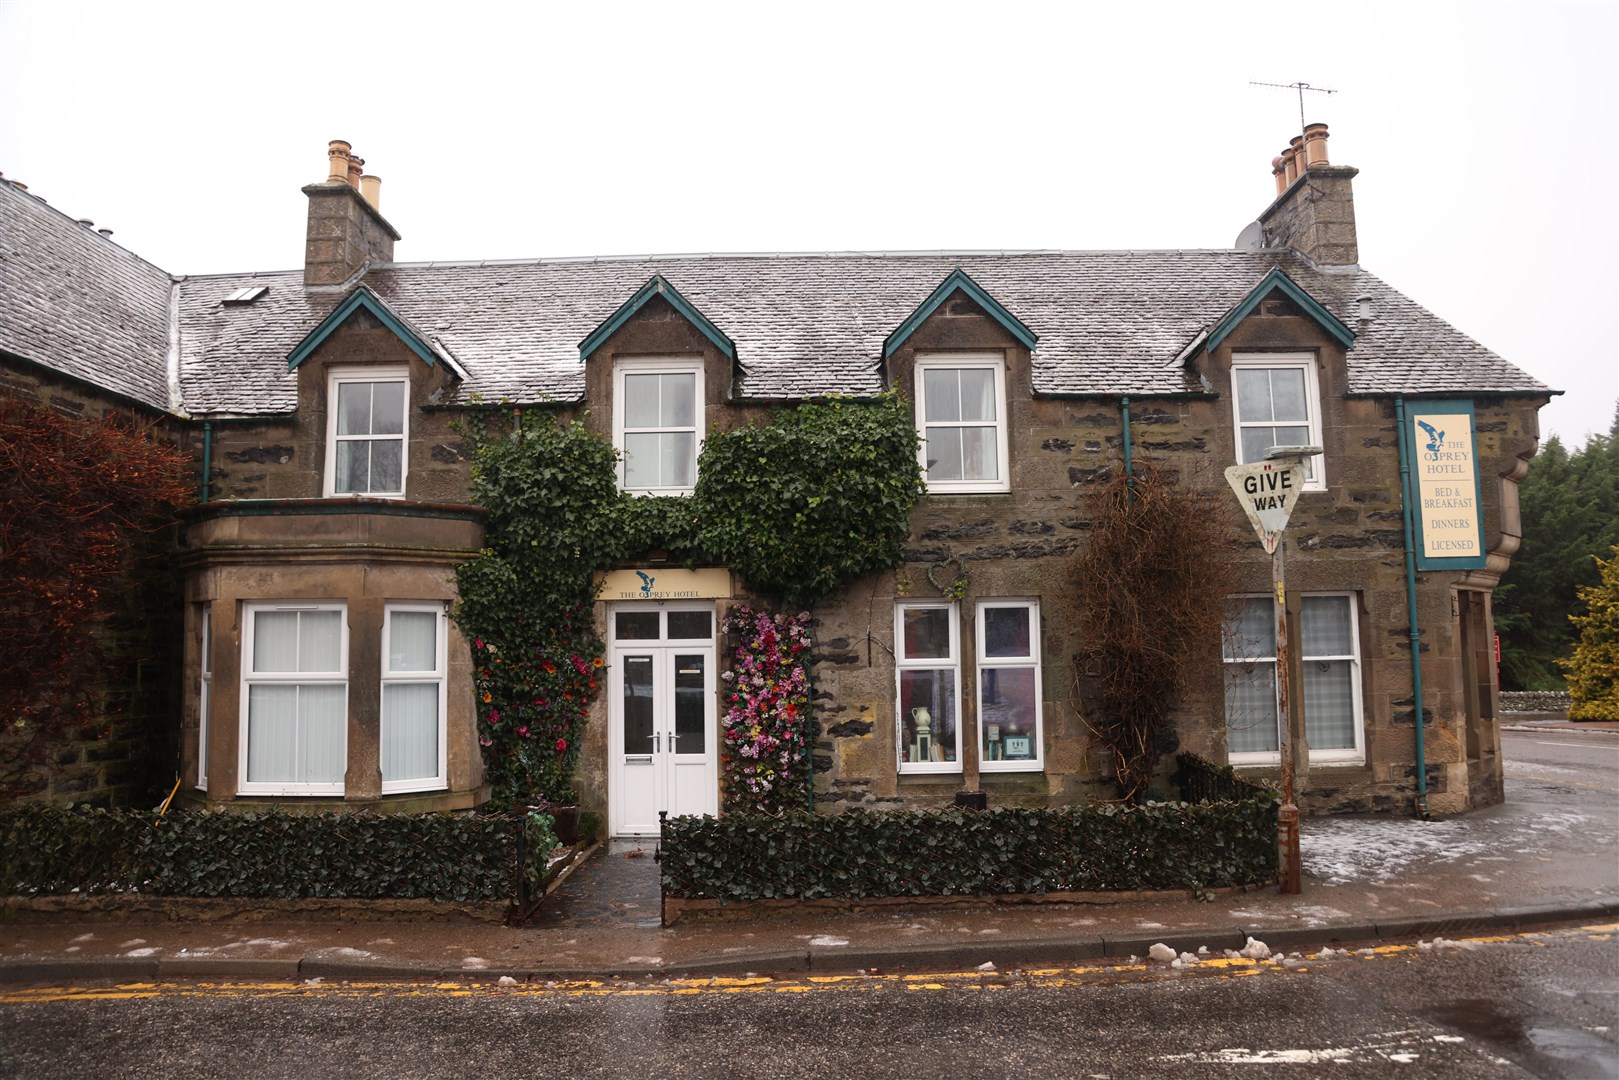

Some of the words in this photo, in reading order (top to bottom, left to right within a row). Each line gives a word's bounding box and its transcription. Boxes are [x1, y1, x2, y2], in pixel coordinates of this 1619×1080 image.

[1427, 464, 1465, 474] HOTEL
[1244, 470, 1292, 494] GIVE
[1435, 487, 1452, 497] BED
[1455, 487, 1461, 496] &
[1254, 495, 1286, 511] WAY
[1424, 498, 1472, 508] BREAKFAST
[1431, 520, 1470, 529] DINNERS
[1431, 540, 1474, 550] LICENSED
